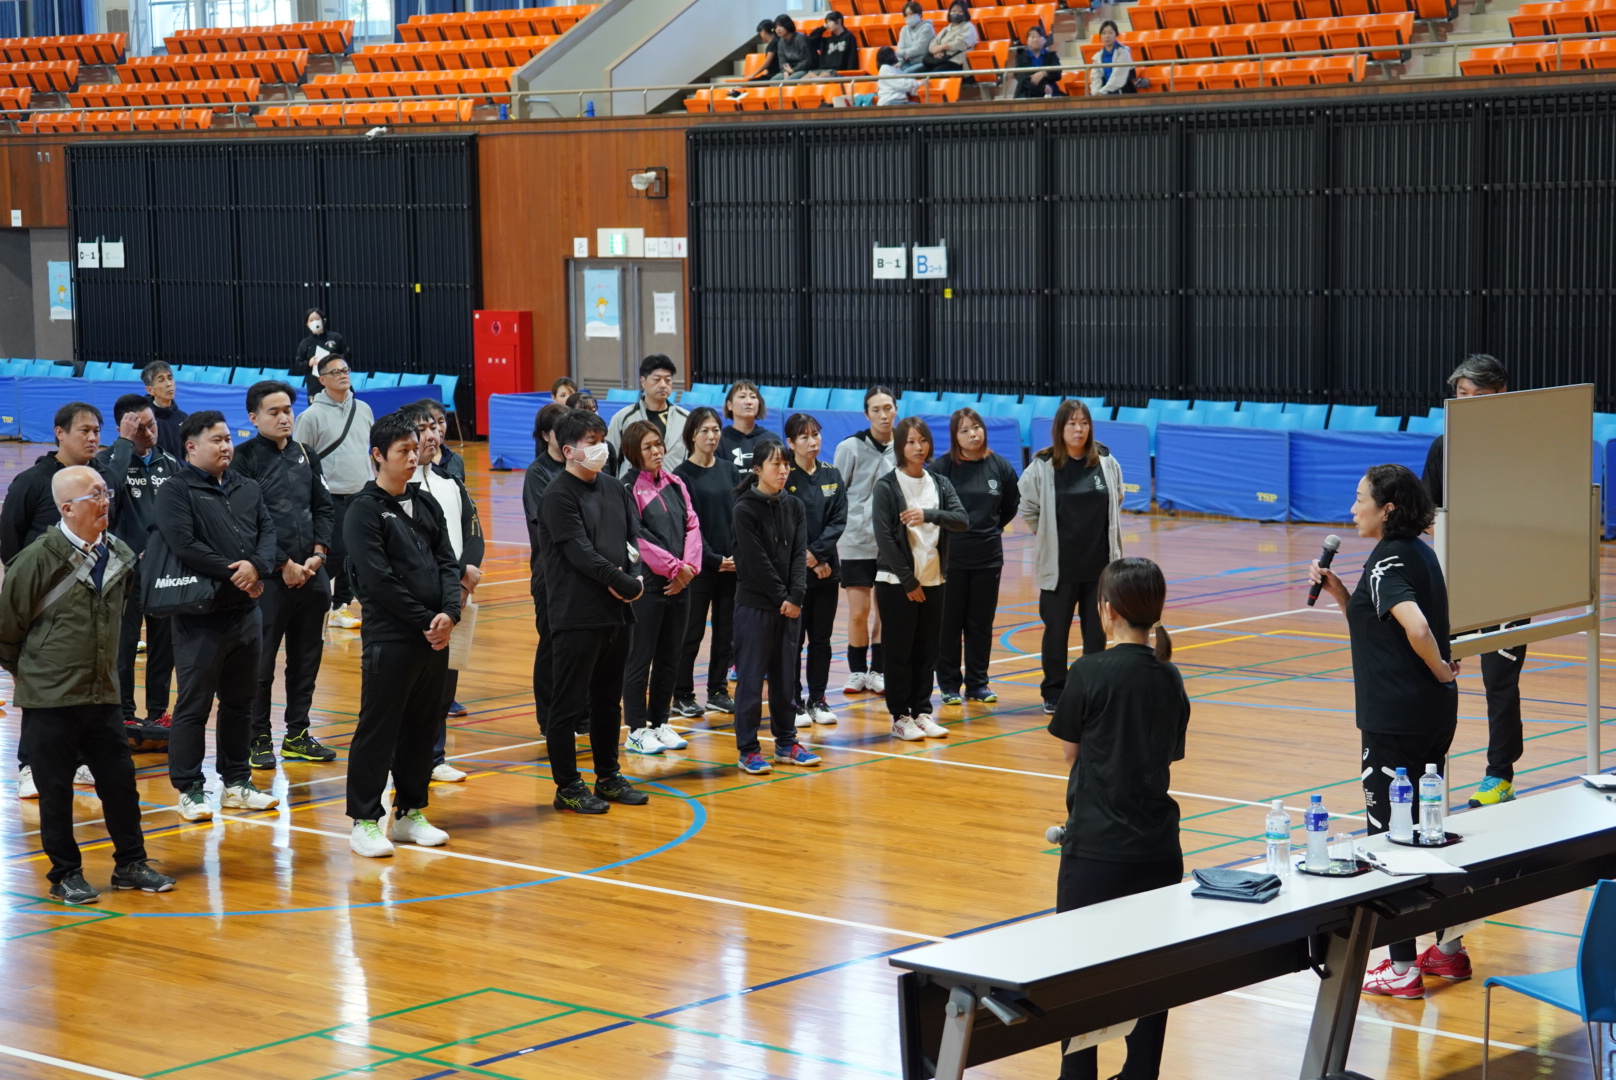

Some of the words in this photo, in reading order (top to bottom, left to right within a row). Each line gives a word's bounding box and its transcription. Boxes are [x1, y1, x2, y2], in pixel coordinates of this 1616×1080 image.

[877, 258, 901, 268] B-1
[917, 255, 943, 274] Bコート
[1256, 492, 1278, 503] TSP
